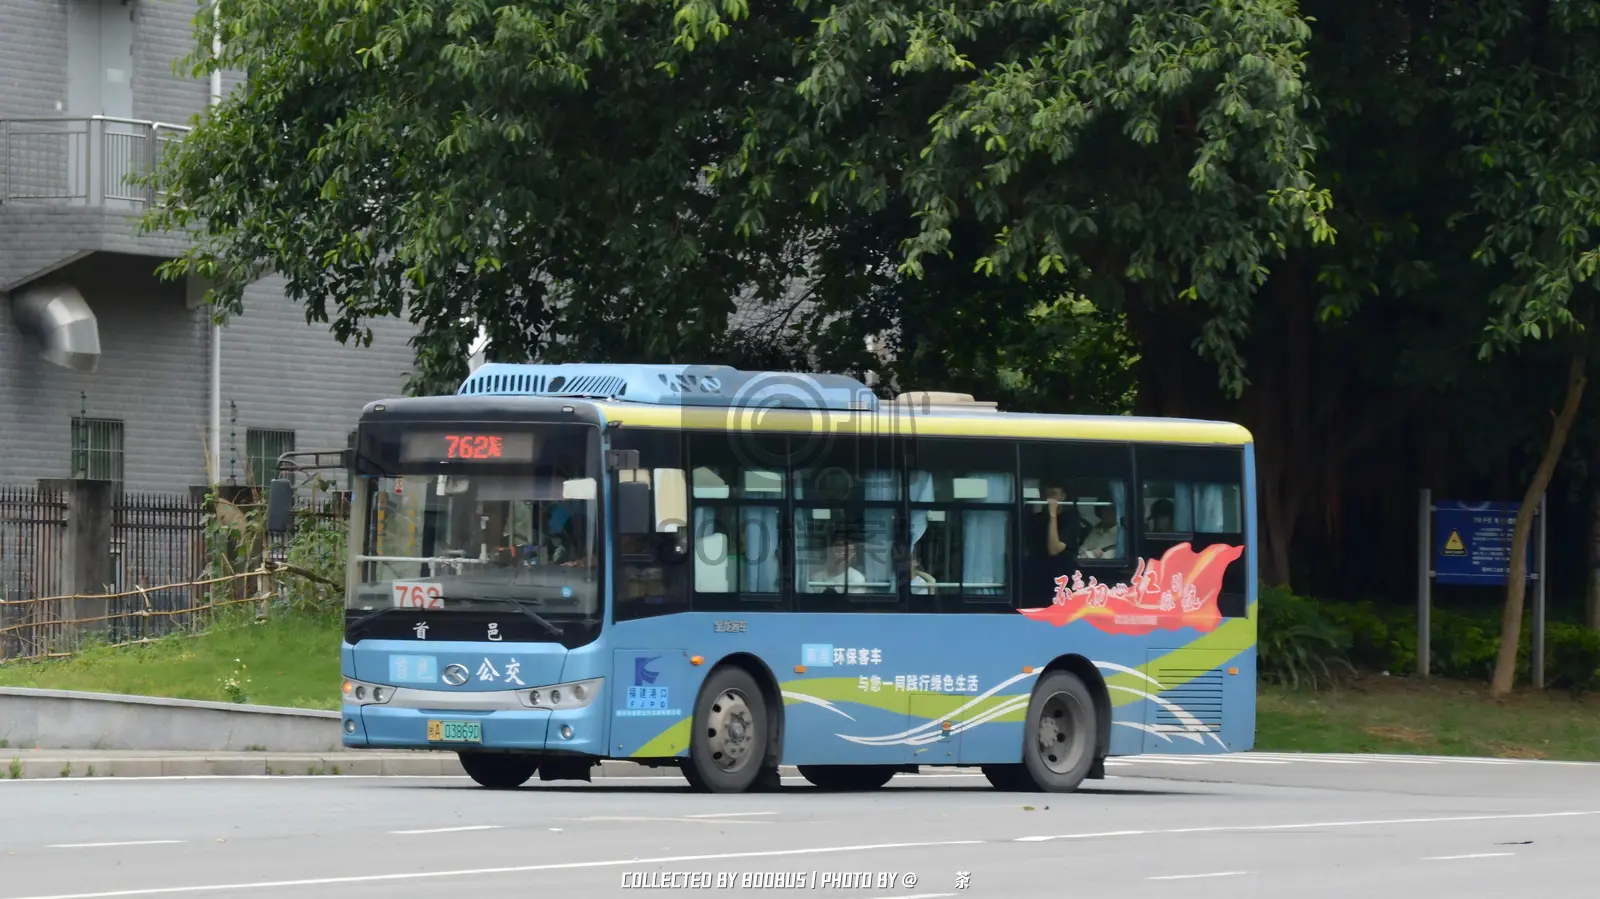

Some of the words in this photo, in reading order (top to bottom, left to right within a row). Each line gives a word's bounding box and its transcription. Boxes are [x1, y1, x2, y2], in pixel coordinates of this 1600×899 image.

[395, 585, 441, 608] 762
[833, 647, 882, 665] 环保客车
[476, 656, 526, 686] 公交
[857, 674, 979, 692] 与您一同践行绿色生活
